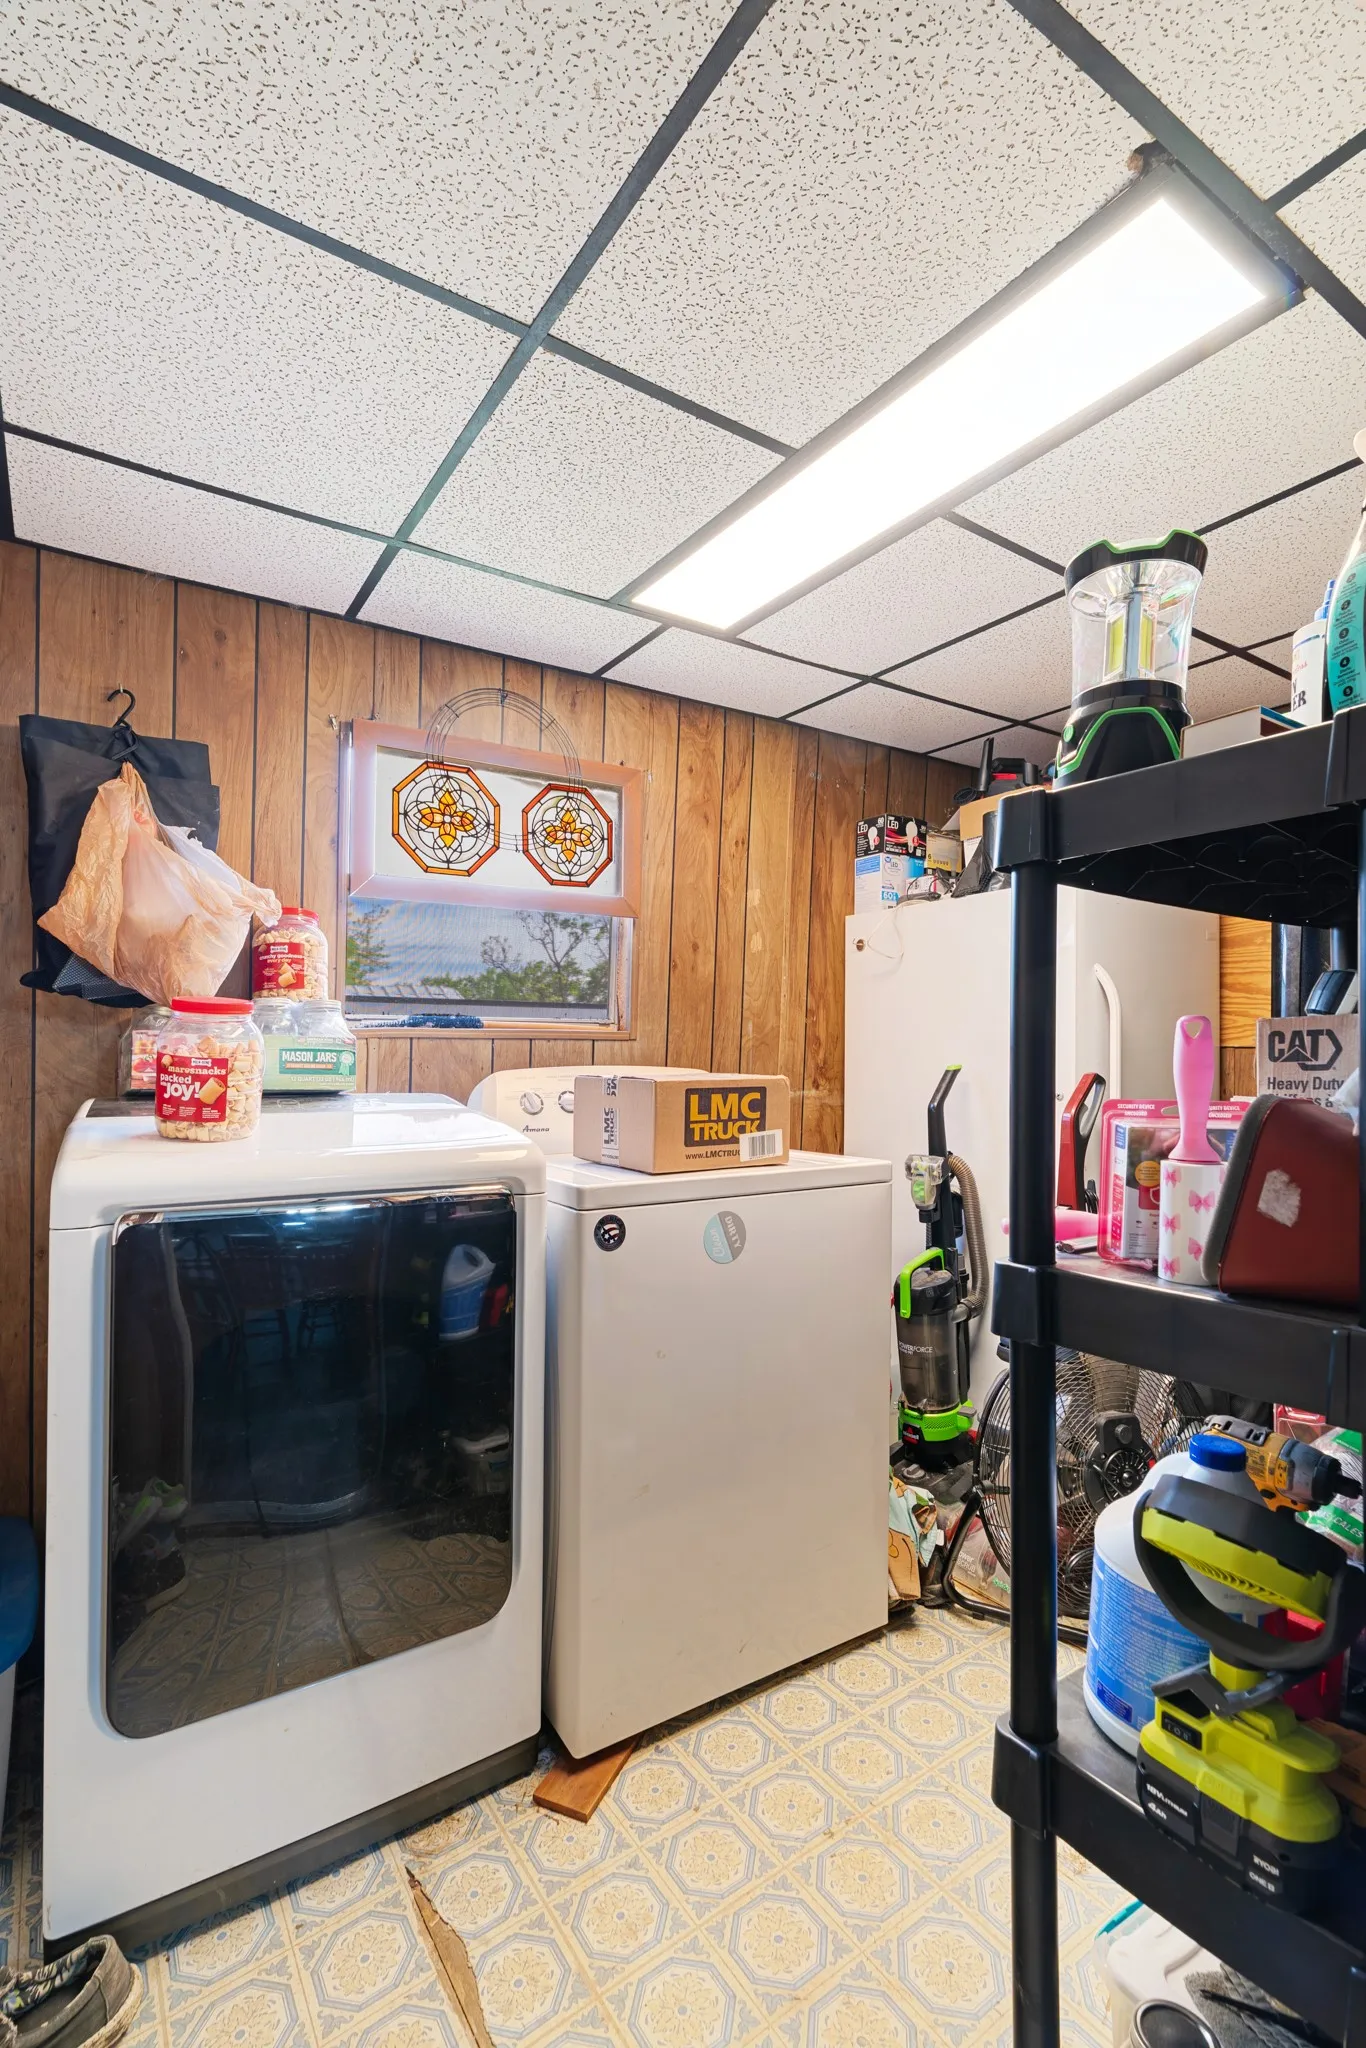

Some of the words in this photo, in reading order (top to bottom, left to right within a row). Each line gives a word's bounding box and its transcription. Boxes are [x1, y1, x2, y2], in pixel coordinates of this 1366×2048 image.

[858, 825, 868, 833] LED
[888, 821, 898, 829] LED
[1268, 1029, 1325, 1063] CAT
[282, 1051, 313, 1062] MASON
[315, 1051, 337, 1063] JARS
[160, 1073, 192, 1084] packed
[168, 1065, 226, 1075] marosnacks
[1267, 1077, 1309, 1094] Heavy
[1312, 1076, 1344, 1091] Duty
[690, 1092, 761, 1121] LMC
[690, 1120, 760, 1141] TRUCK
[724, 1215, 742, 1248] DIRTY
[1332, 1514, 1364, 1538] CALES
[1252, 1854, 1280, 1877] RYOBI
